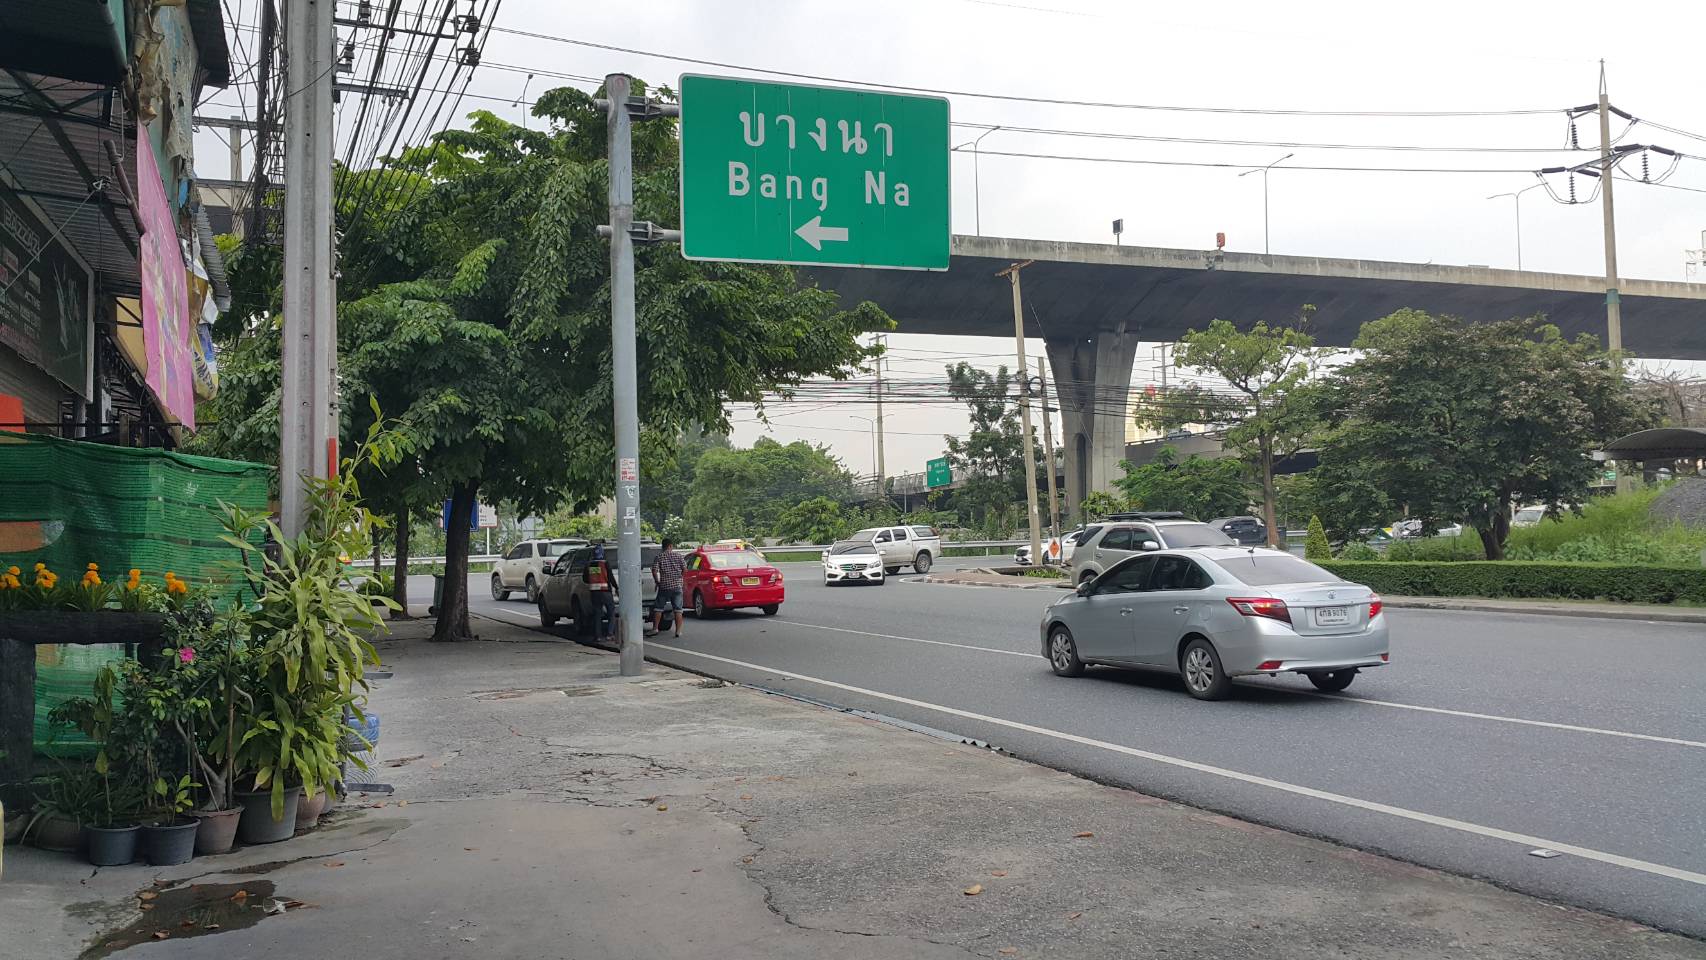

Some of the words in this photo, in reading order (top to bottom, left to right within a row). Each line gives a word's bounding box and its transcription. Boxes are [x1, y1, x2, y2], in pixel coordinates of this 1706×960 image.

[739, 111, 893, 156] บางนา
[728, 161, 828, 211] Bang
[864, 170, 909, 206] Na
